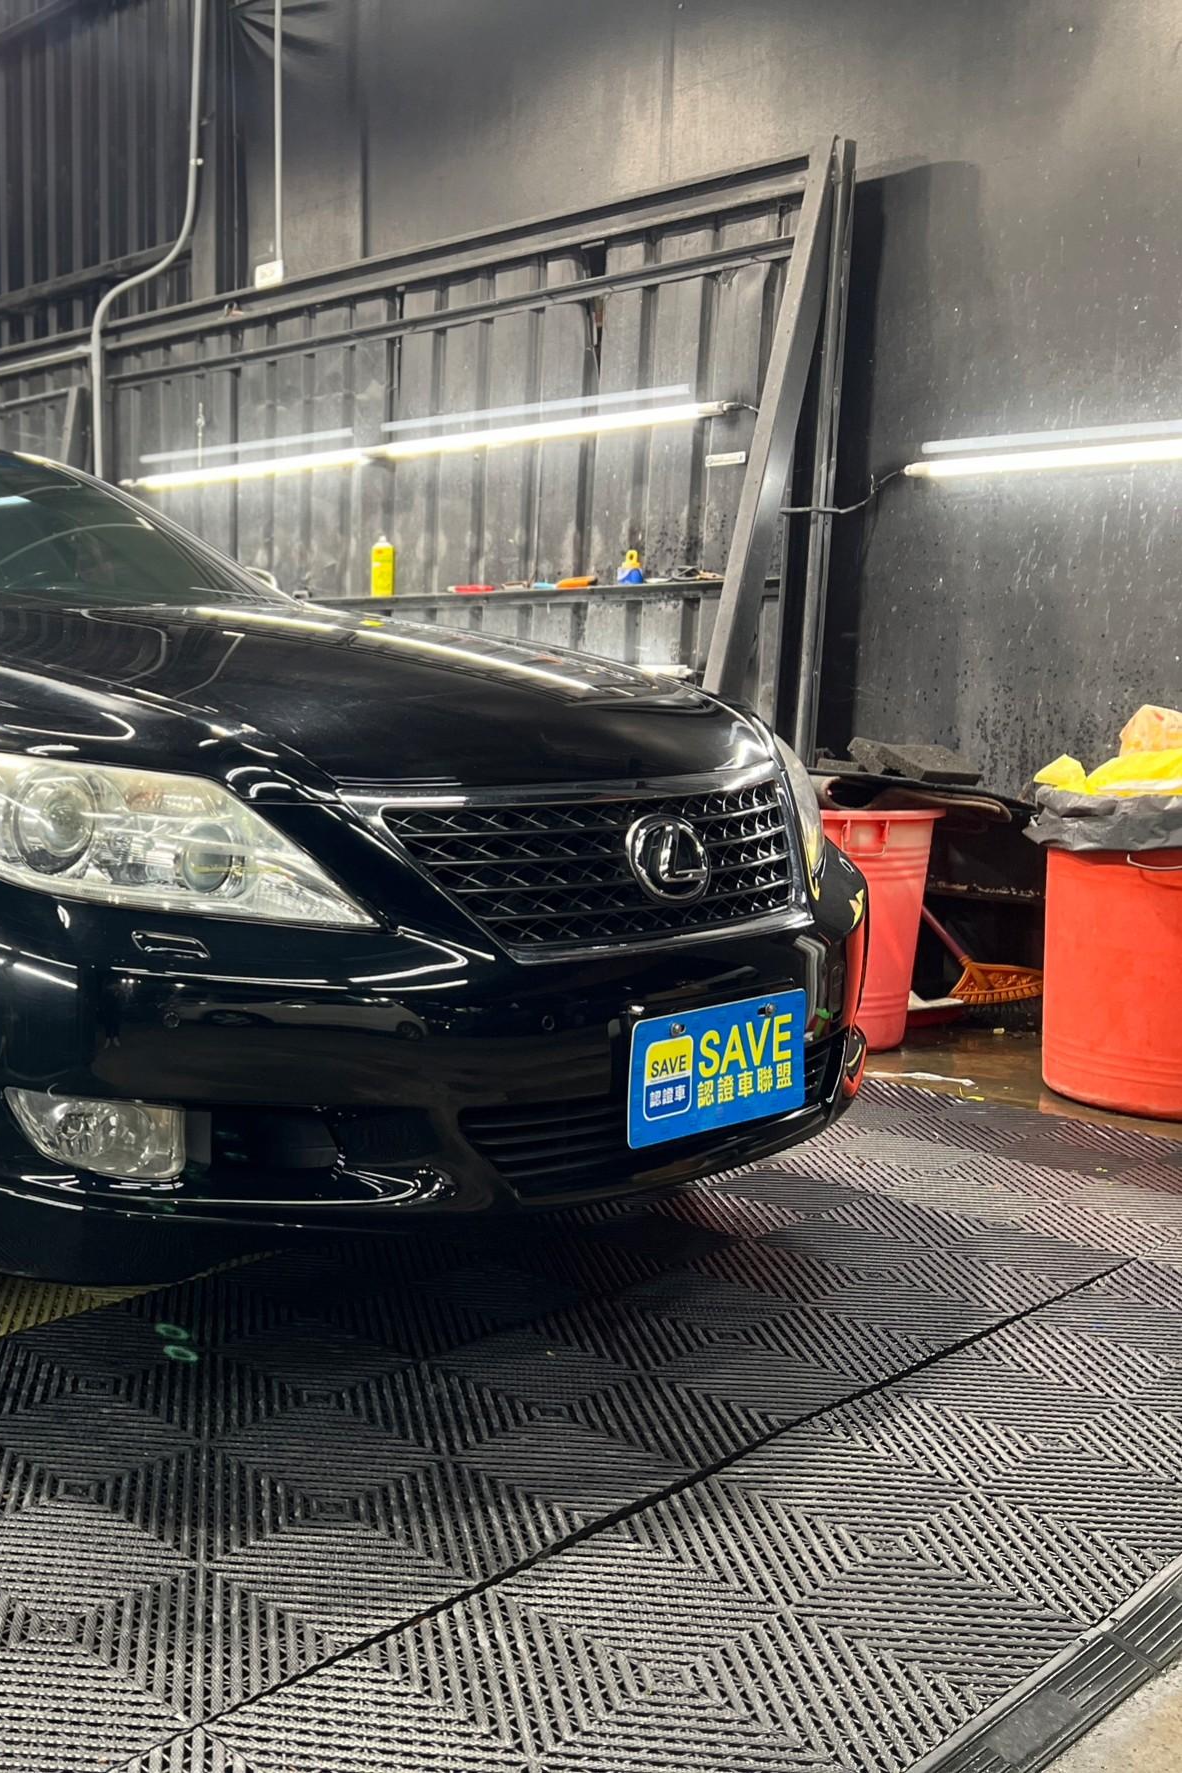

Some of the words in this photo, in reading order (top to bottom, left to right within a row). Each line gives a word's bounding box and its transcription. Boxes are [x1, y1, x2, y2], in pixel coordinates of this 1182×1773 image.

[698, 1013, 793, 1078] SAVE
[651, 1054, 687, 1078] SAVE
[649, 1084, 687, 1109] 認證車
[697, 1061, 793, 1109] 認證車聯盟
